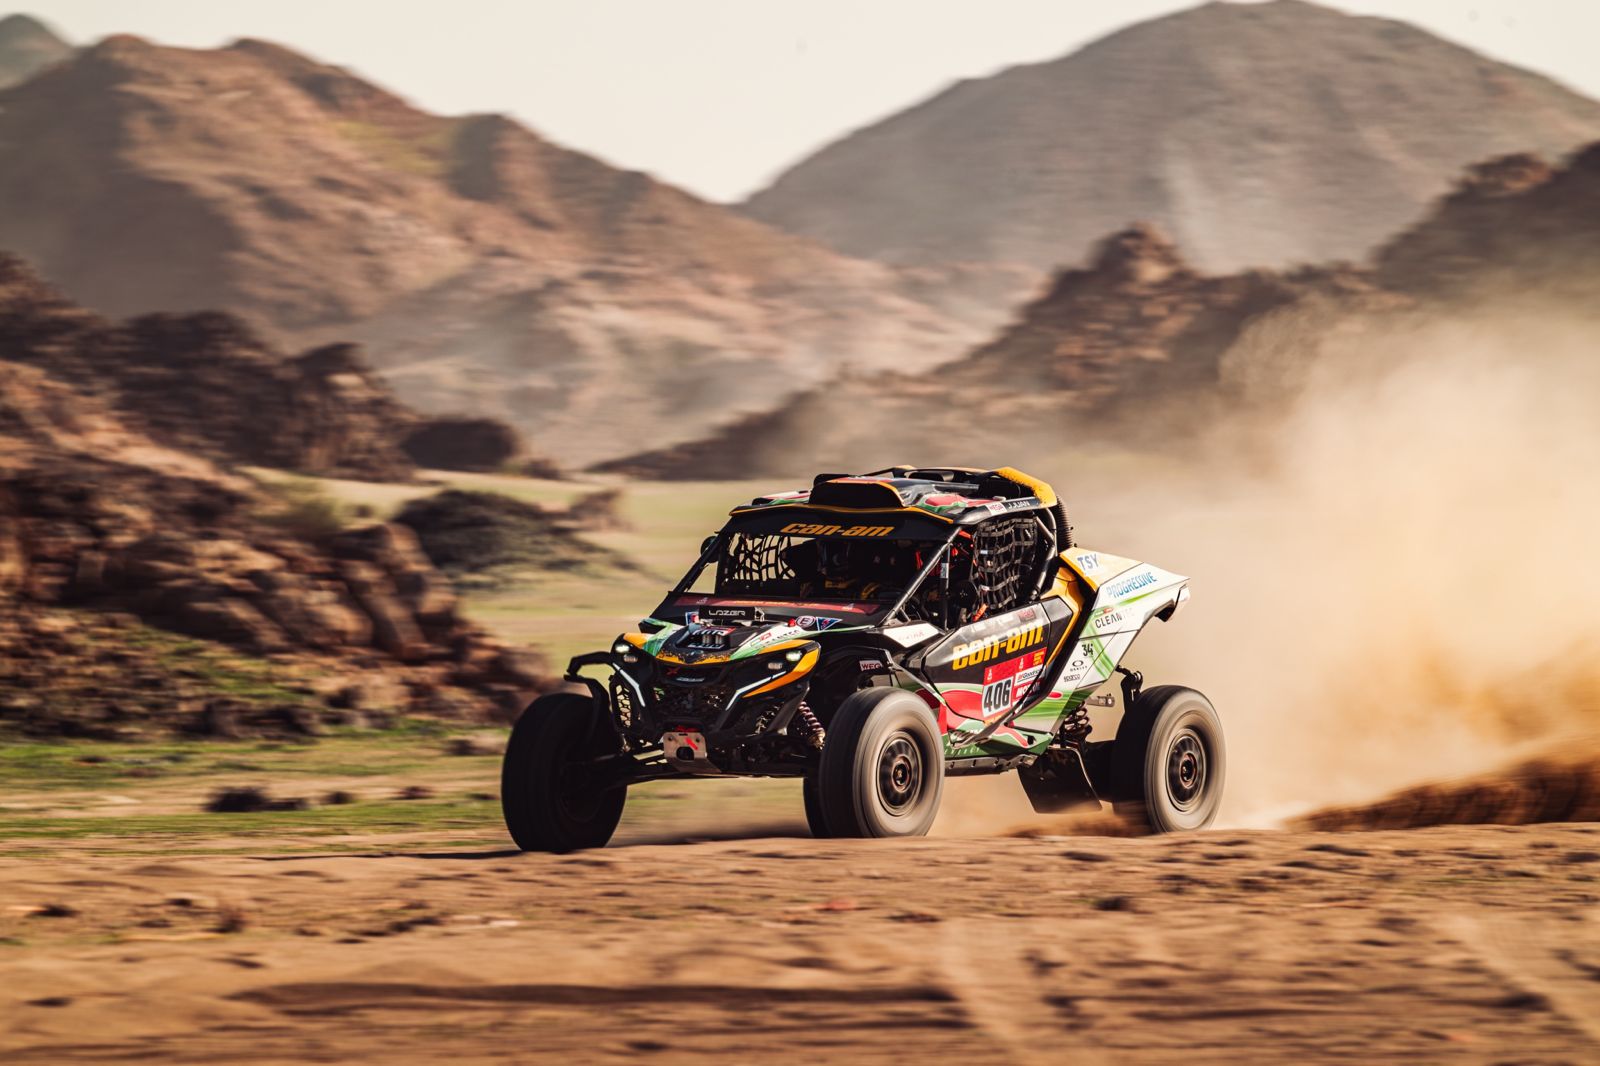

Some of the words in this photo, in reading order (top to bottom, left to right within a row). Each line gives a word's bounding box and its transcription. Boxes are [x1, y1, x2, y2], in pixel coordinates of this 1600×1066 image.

[780, 523, 895, 537] can-am
[1077, 553, 1099, 571] TSY
[952, 622, 1043, 671] can-am
[983, 679, 1012, 712] 406
